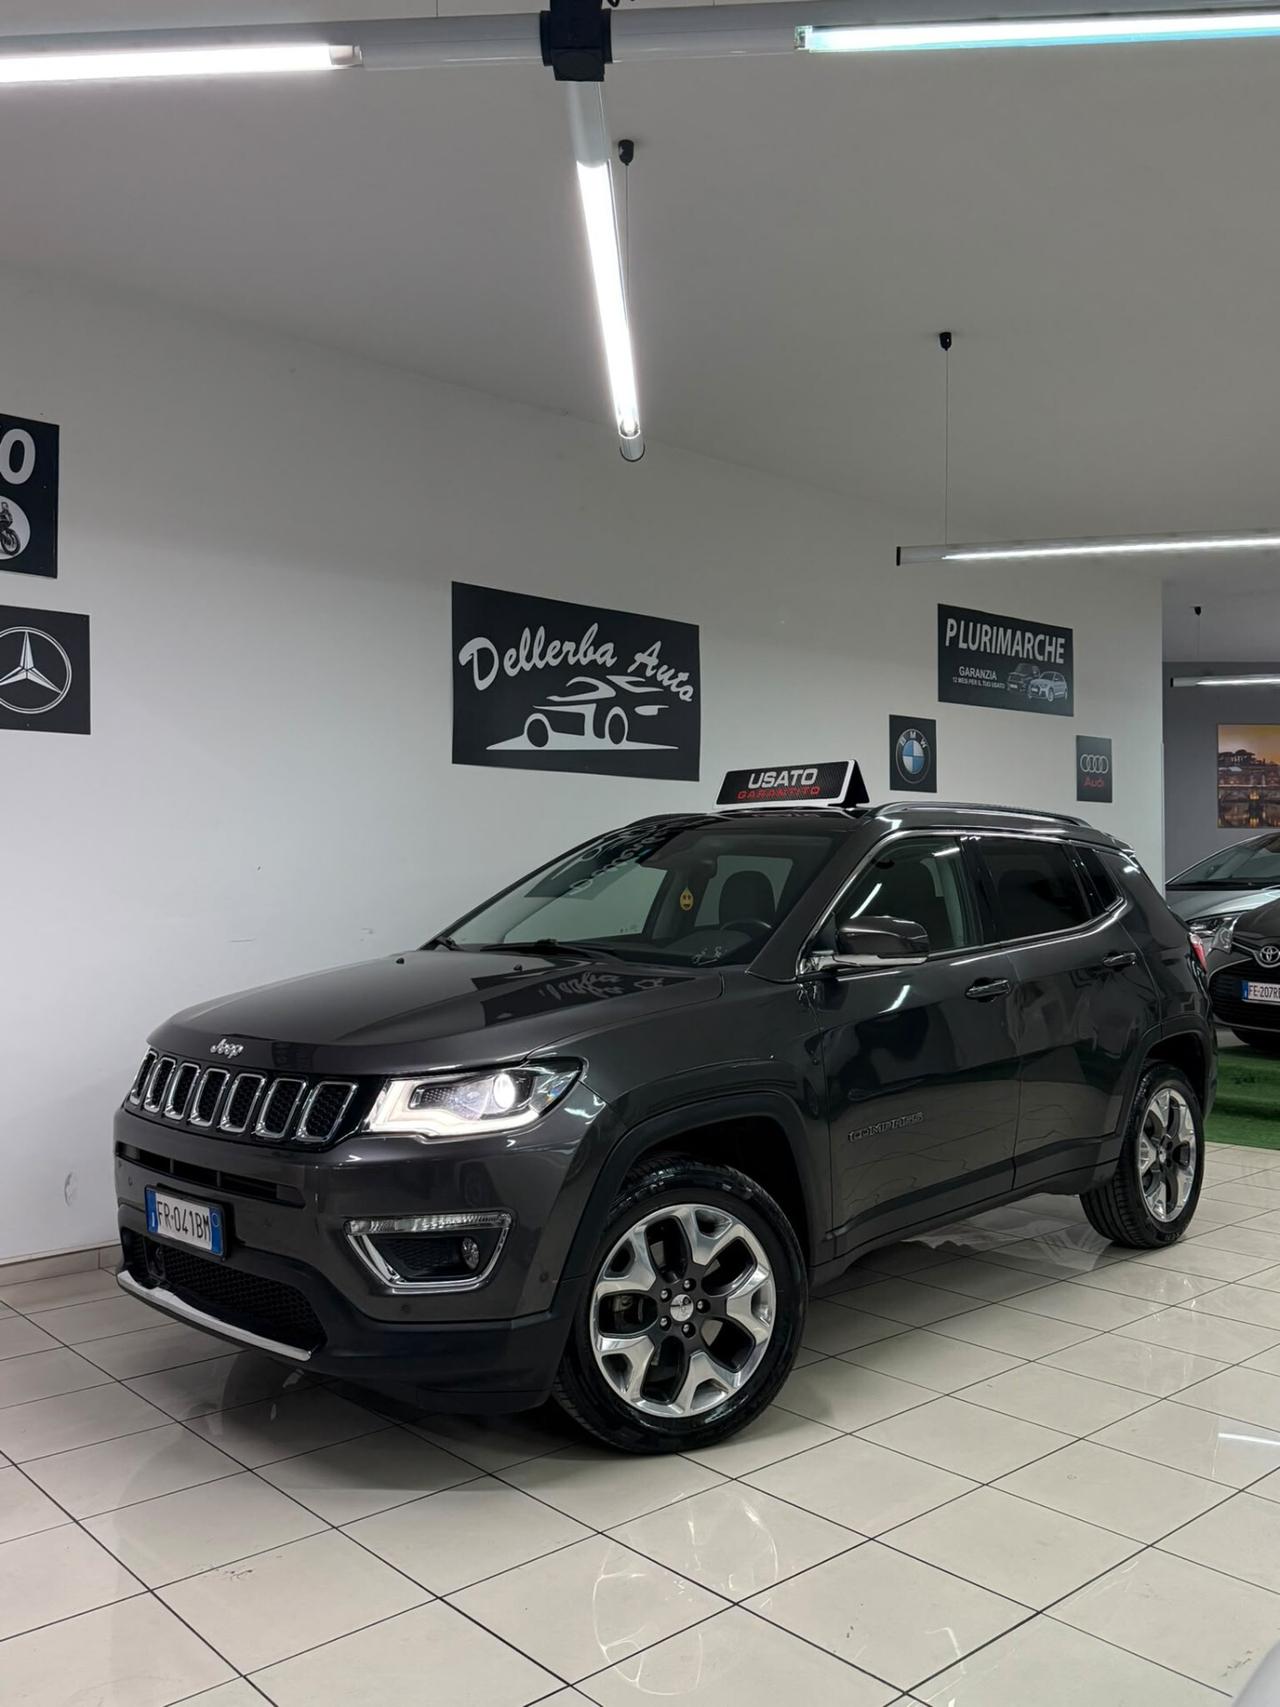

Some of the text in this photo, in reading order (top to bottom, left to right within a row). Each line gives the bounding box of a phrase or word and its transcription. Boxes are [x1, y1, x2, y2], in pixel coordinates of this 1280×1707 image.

[945, 618, 1066, 664] PLURIMARCHE
[458, 622, 694, 702] Dellerba Auto
[959, 666, 998, 680] GARANZIA
[968, 678, 977, 686] PER
[991, 681, 1006, 689] USATO
[899, 731, 928, 748] BMW
[747, 768, 818, 789] USATO
[1083, 776, 1105, 788] Audi
[736, 786, 821, 800] GARANTITO
[210, 1038, 244, 1059] Jeep
[848, 1112, 924, 1142] COMPASS
